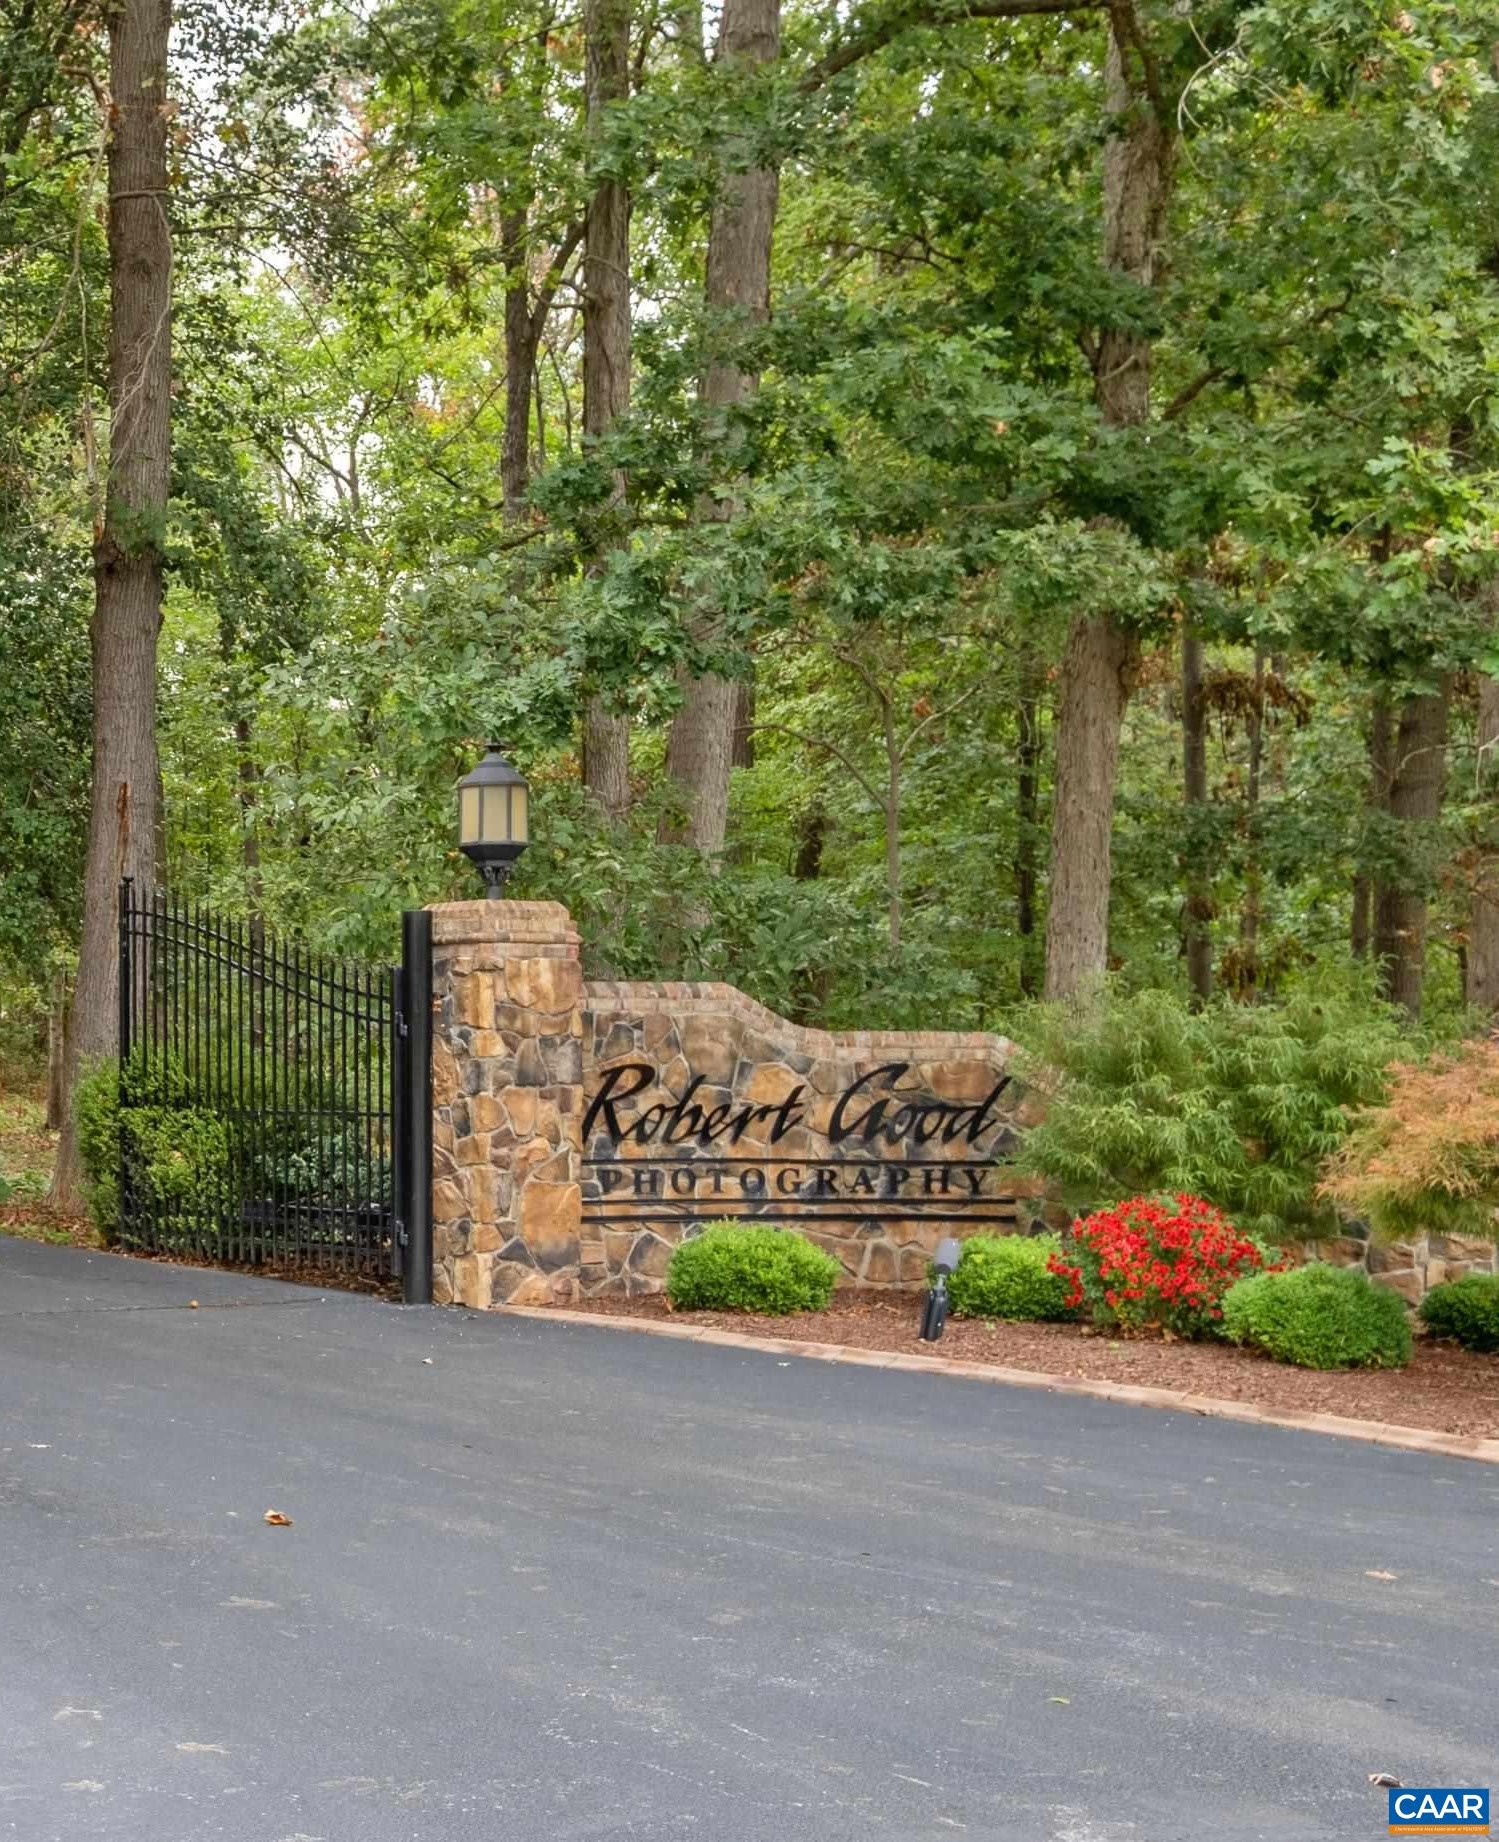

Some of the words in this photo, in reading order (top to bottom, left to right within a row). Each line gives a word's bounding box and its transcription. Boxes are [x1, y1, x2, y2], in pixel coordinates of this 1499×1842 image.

[582, 1063, 805, 1145] Robert
[829, 1063, 1012, 1145] Good
[599, 1167, 991, 1194] PHOTOGRAPHY
